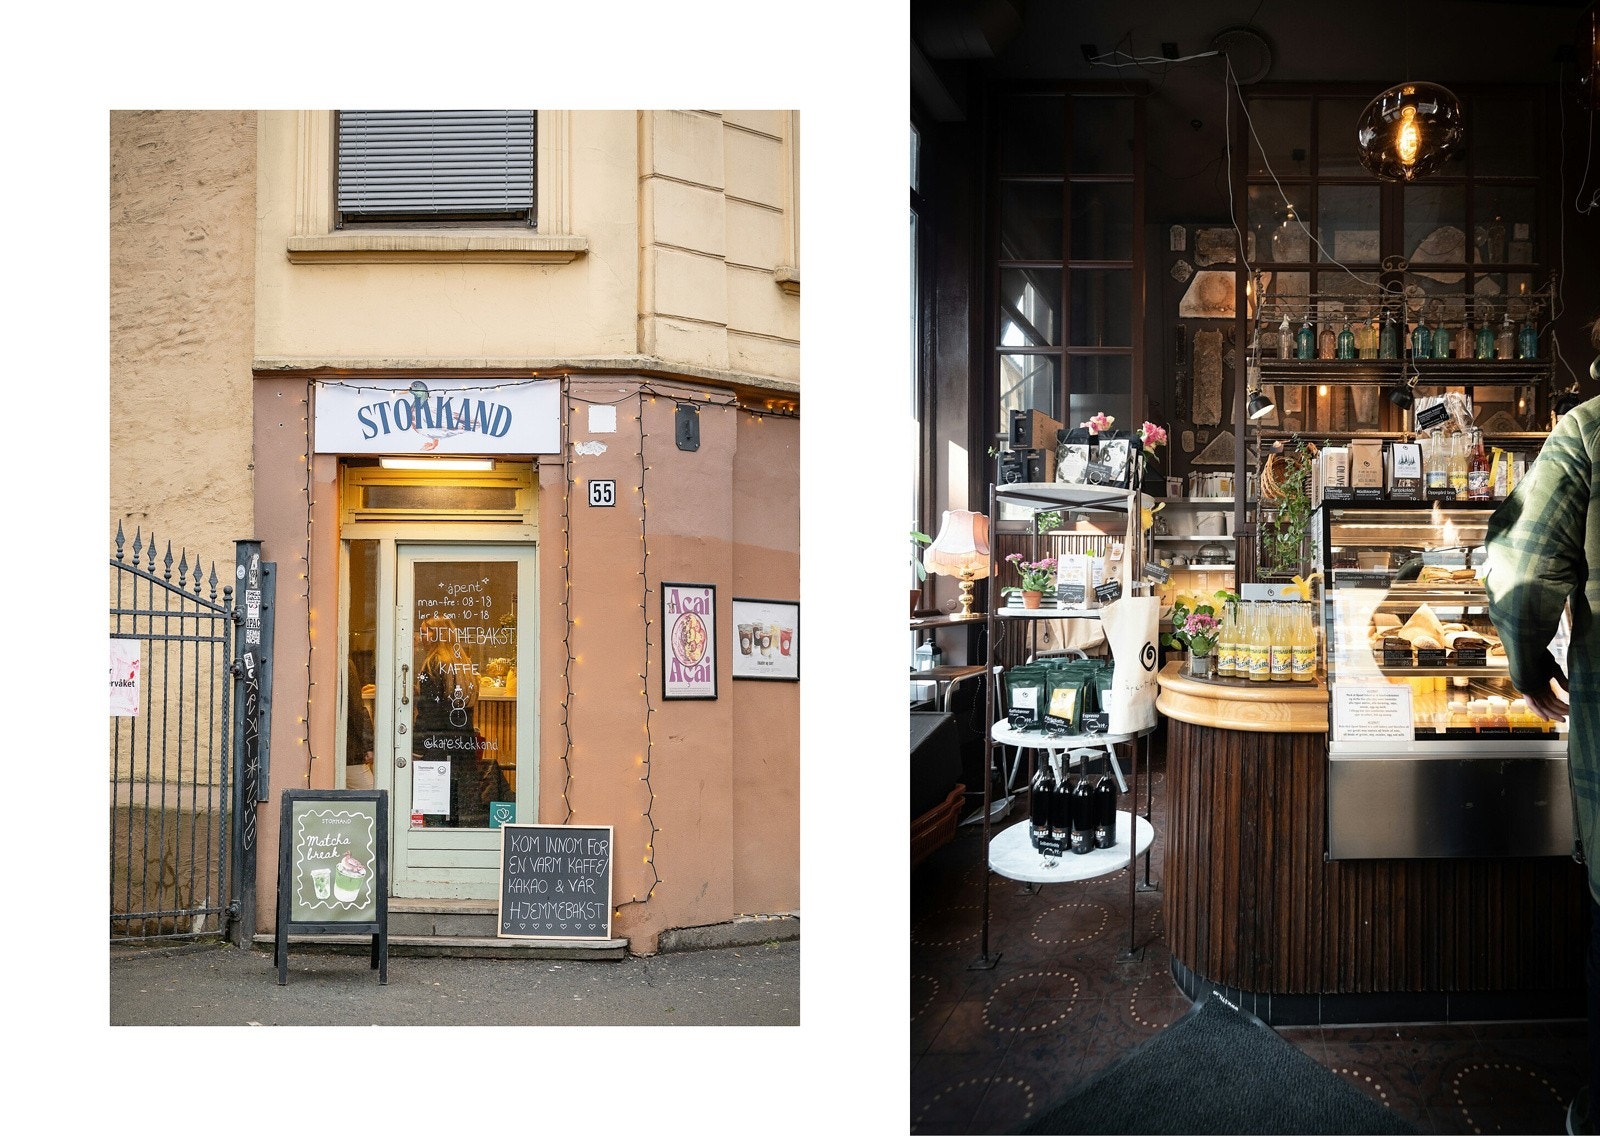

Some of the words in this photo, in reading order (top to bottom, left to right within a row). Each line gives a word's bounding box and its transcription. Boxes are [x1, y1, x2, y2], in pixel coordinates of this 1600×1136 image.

[357, 396, 512, 440] STOKKAND
[593, 483, 612, 503] 55
[447, 581, 483, 597] åpent
[420, 626, 516, 645] HJEMMEBAKST
[453, 643, 462, 659] &
[439, 661, 479, 675] KAFFE
[669, 656, 710, 687] Açai
[424, 735, 498, 750] @kafestokkand
[307, 833, 351, 847] Matcha
[511, 835, 540, 853] KOM
[545, 836, 583, 855] INNOM
[587, 838, 609, 857] FOR
[307, 847, 340, 861] break
[508, 855, 527, 875] EN
[529, 856, 562, 873] VARM
[508, 878, 549, 894] KAKAO
[555, 879, 564, 894] &
[568, 875, 596, 895] VÅR
[510, 901, 605, 921] HJEMMEBAKST
